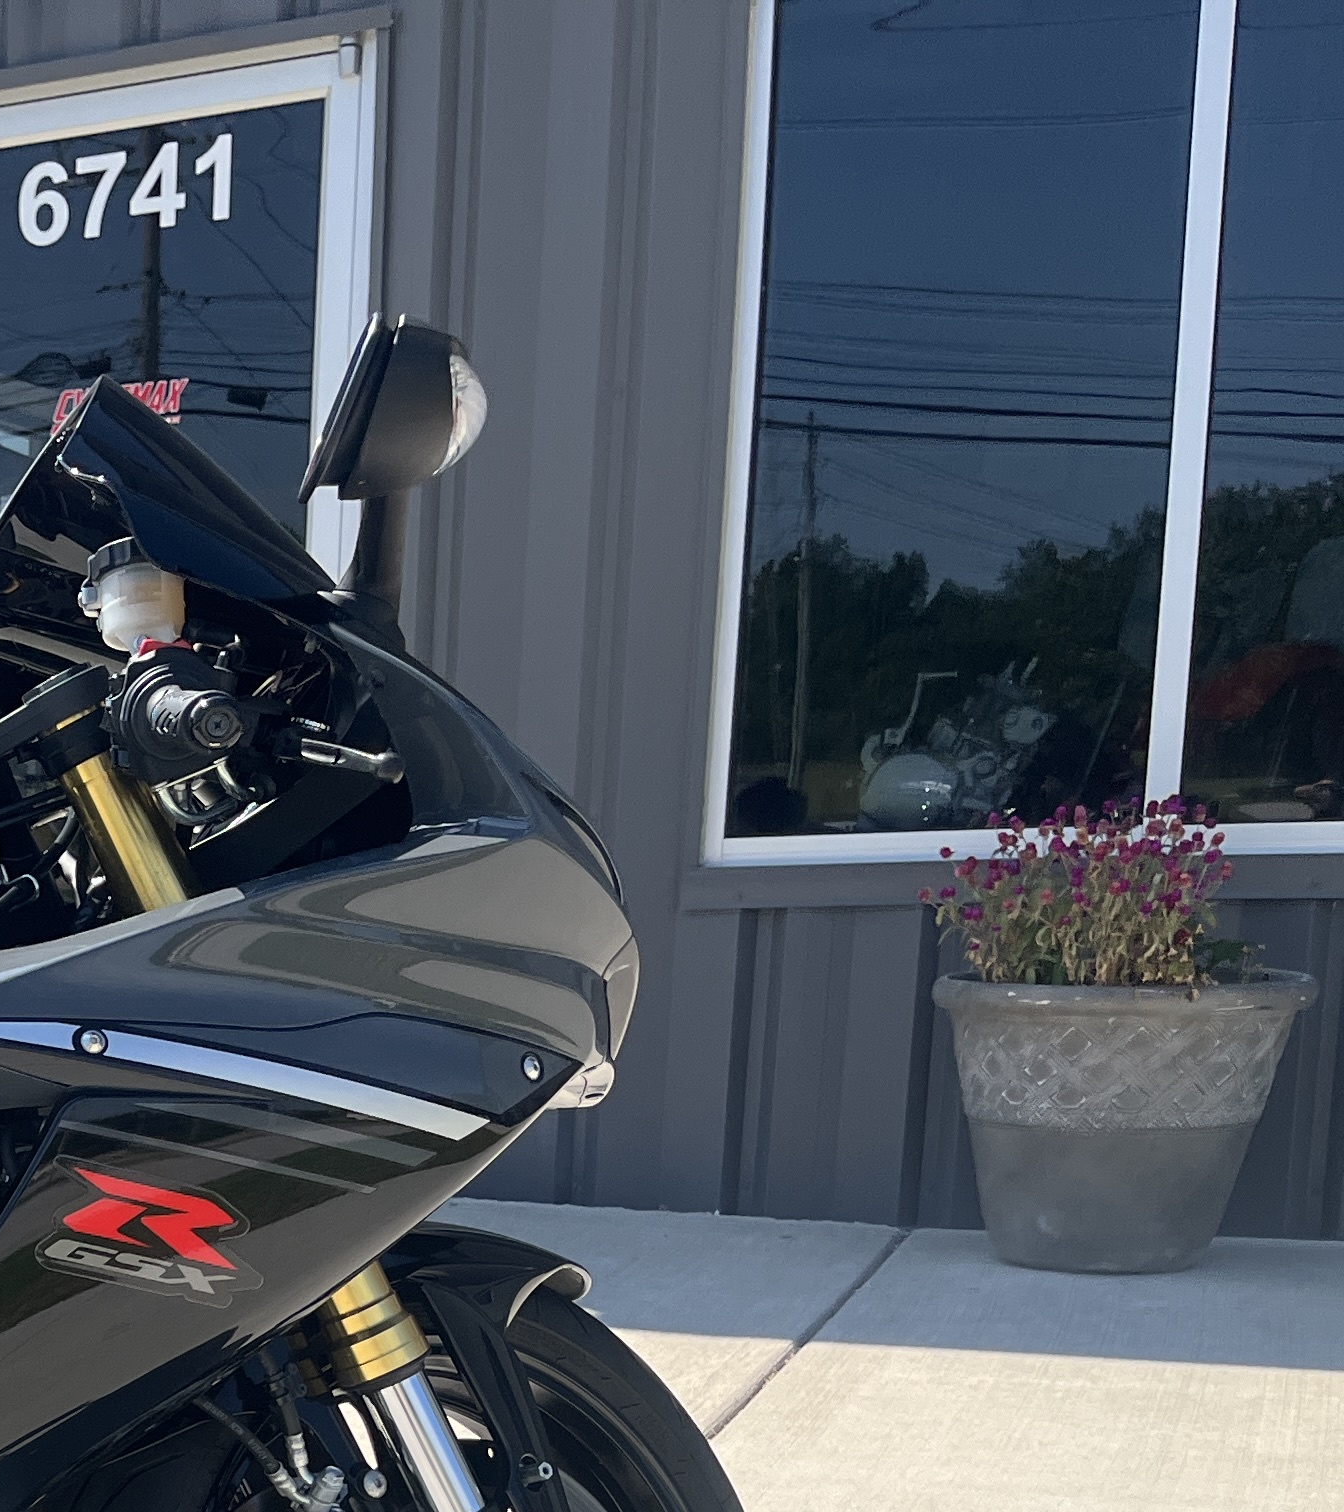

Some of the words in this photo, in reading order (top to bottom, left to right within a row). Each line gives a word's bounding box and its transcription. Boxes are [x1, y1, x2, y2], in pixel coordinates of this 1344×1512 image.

[18, 133, 233, 248] 6741
[44, 1238, 237, 1295] GSX
[62, 1166, 238, 1270] R
